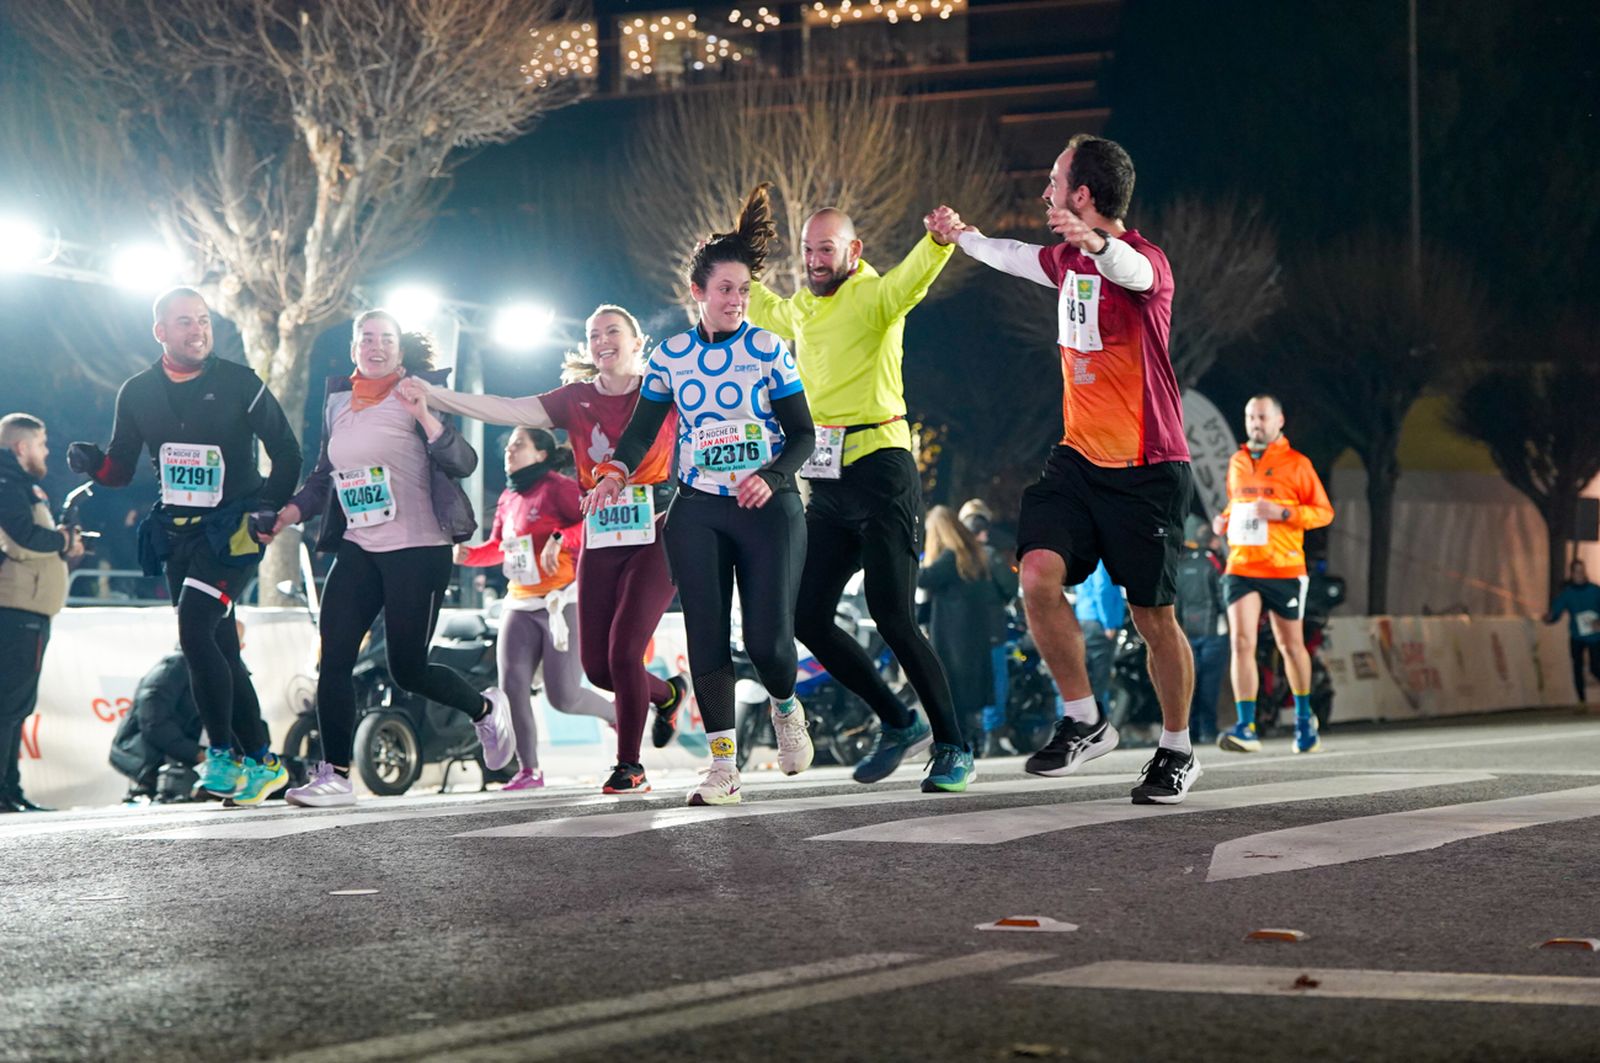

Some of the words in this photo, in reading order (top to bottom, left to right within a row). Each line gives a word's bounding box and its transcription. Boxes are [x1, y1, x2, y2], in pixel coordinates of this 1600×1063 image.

[706, 428, 729, 438] NOCHE
[730, 426, 738, 434] DE
[702, 442, 760, 466] 12376
[169, 466, 214, 486] 12191
[344, 484, 385, 507] 12462
[598, 505, 640, 526] 9401
